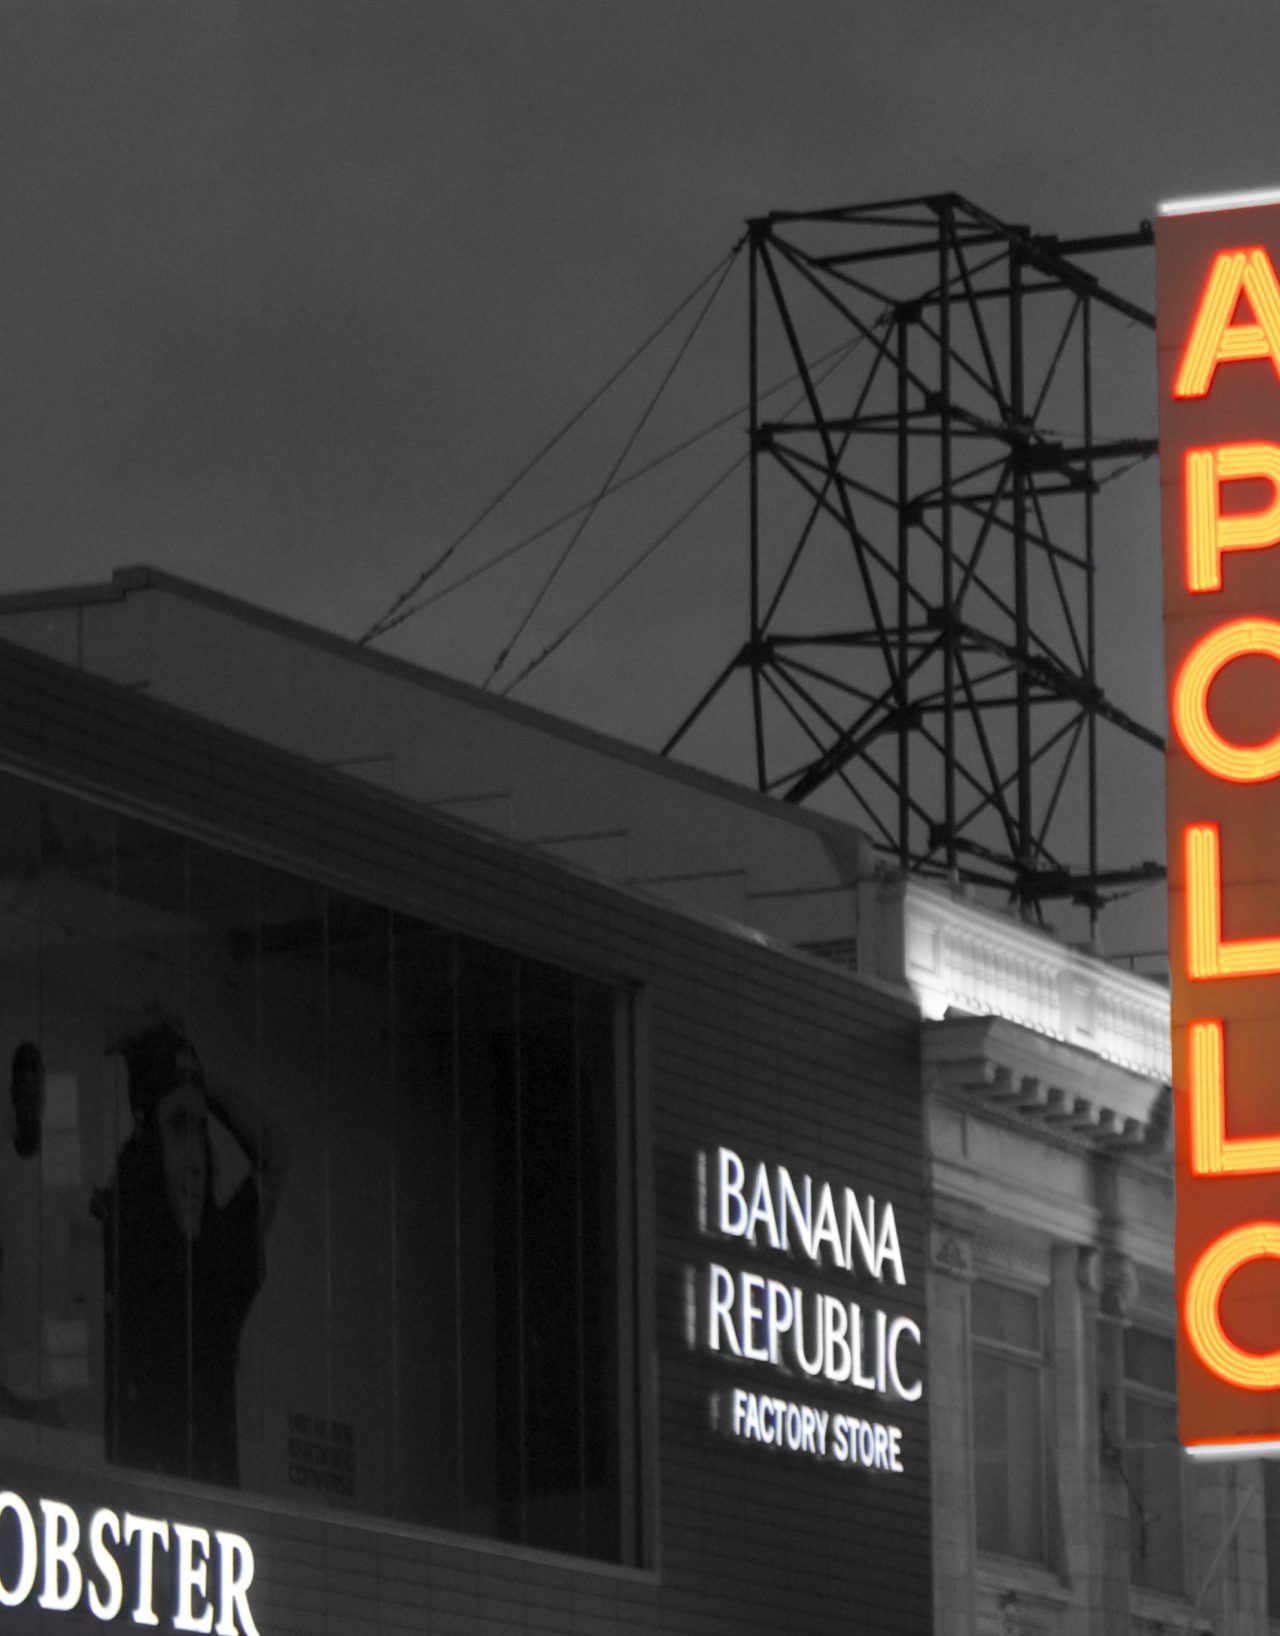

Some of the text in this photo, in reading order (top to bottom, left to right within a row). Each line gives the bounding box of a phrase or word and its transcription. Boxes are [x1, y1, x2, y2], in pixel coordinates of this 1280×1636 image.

[718, 1145, 908, 1286] BANANA
[707, 1262, 924, 1402] REPUBLIC
[732, 1388, 906, 1474] FACTORY STORE
[0, 1490, 260, 1636] OBSTER
